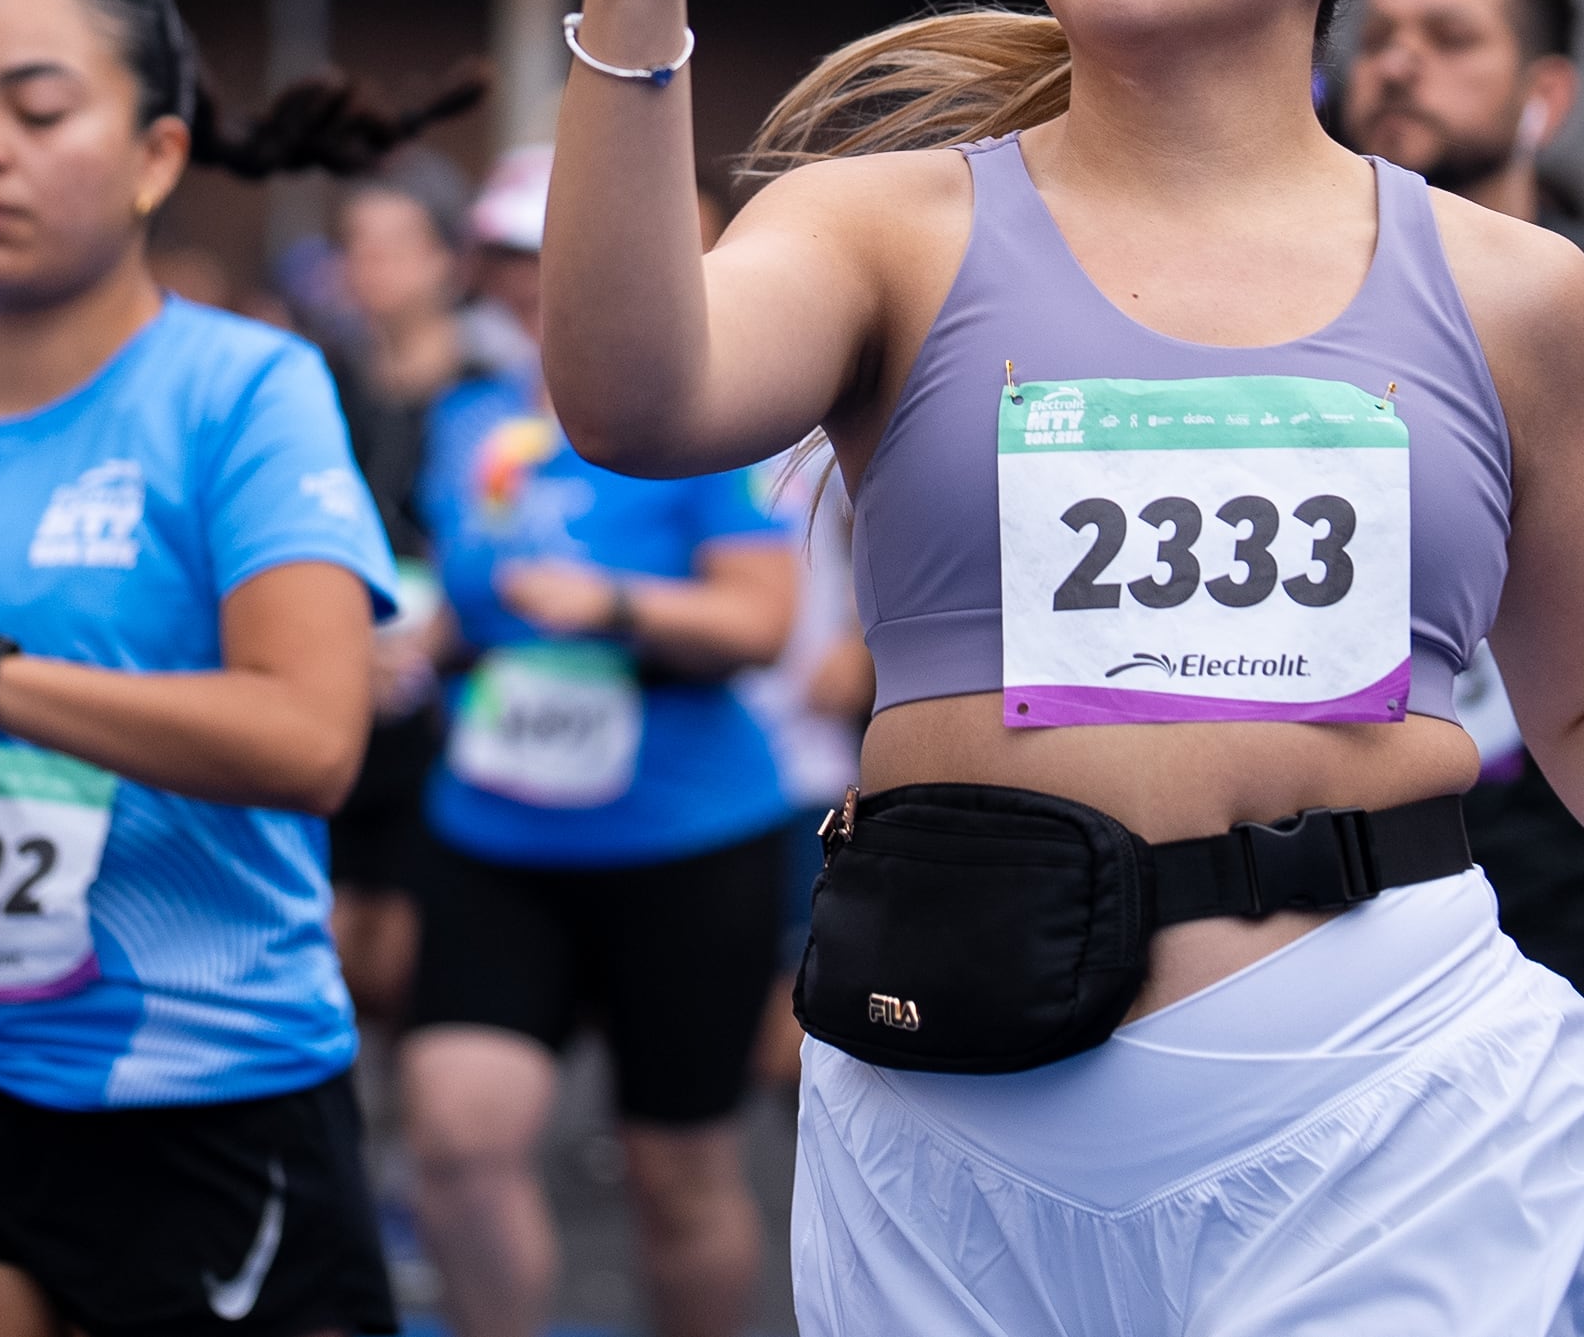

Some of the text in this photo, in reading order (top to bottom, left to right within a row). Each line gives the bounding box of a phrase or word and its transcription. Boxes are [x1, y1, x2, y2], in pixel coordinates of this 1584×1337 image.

[1026, 410, 1085, 431] MTY
[1052, 494, 1357, 612] 2333
[1180, 653, 1310, 677] Electrolit
[868, 993, 920, 1031] FILA
